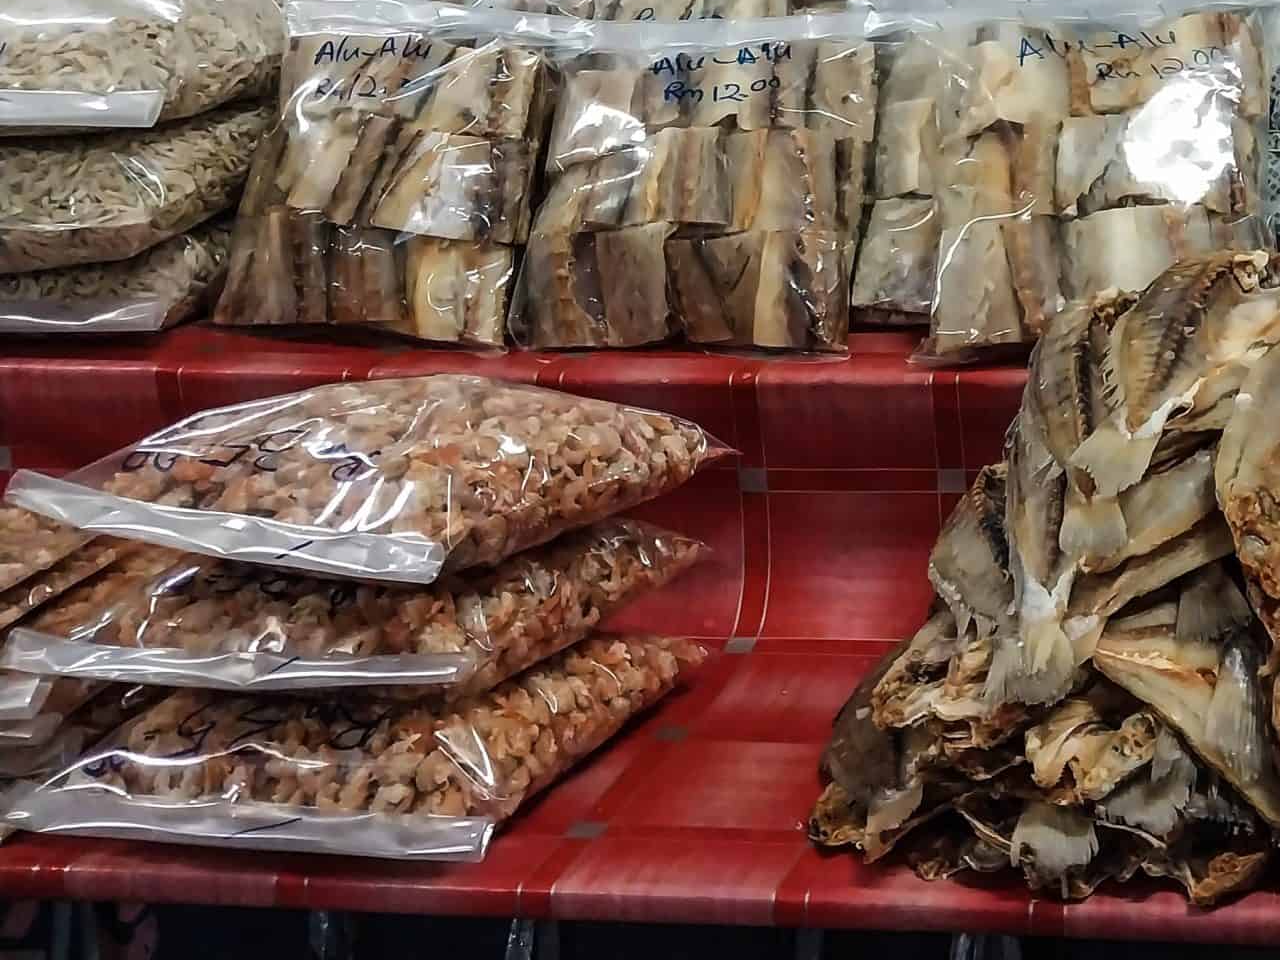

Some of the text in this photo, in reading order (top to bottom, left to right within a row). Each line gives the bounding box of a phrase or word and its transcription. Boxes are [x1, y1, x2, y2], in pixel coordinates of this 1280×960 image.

[314, 34, 433, 65] Alu-Alu
[1016, 30, 1177, 67] Alu-Alu
[712, 75, 781, 103] 12.00
